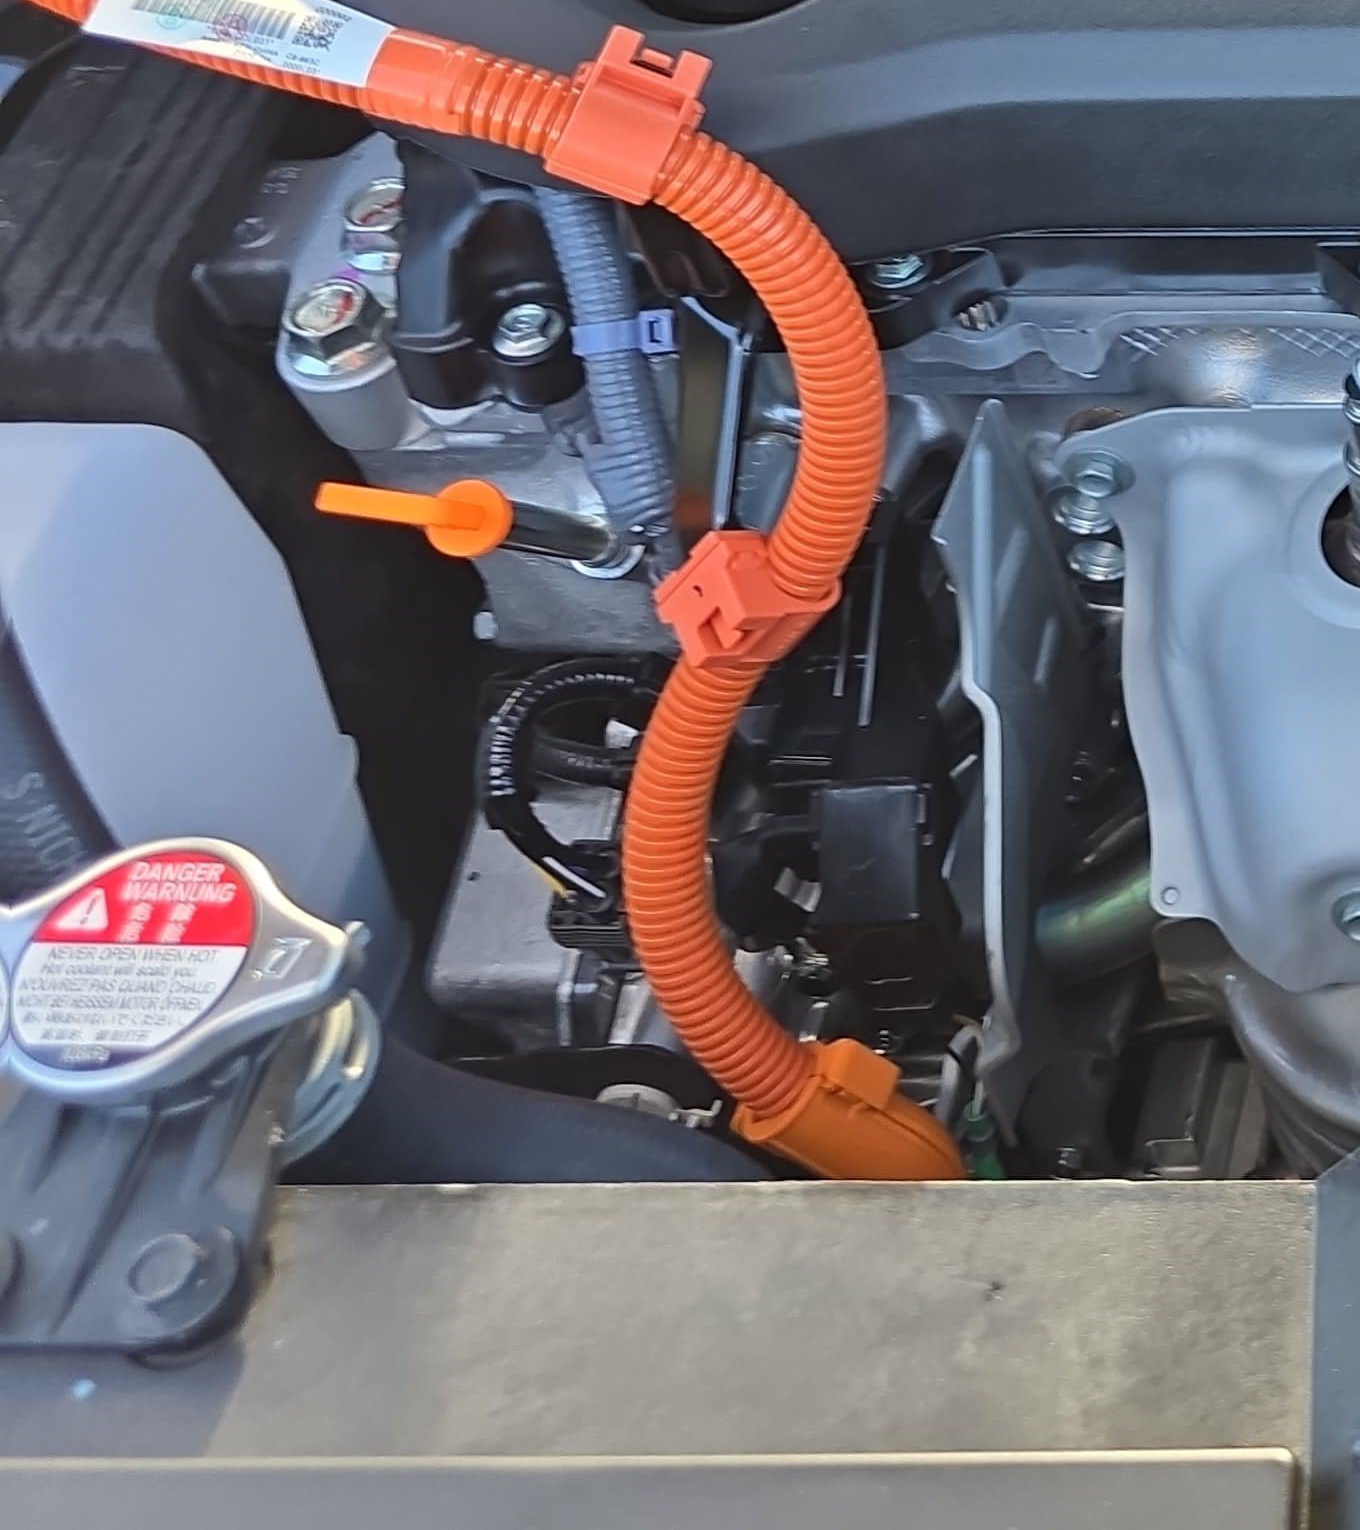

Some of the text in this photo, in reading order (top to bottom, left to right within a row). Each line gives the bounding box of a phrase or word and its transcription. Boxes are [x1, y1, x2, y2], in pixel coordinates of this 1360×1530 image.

[130, 861, 225, 882] DANGER
[120, 882, 237, 903] WARNUNG
[48, 948, 98, 961] NEVER
[99, 948, 138, 961] OPEN
[141, 948, 187, 962] WHEN
